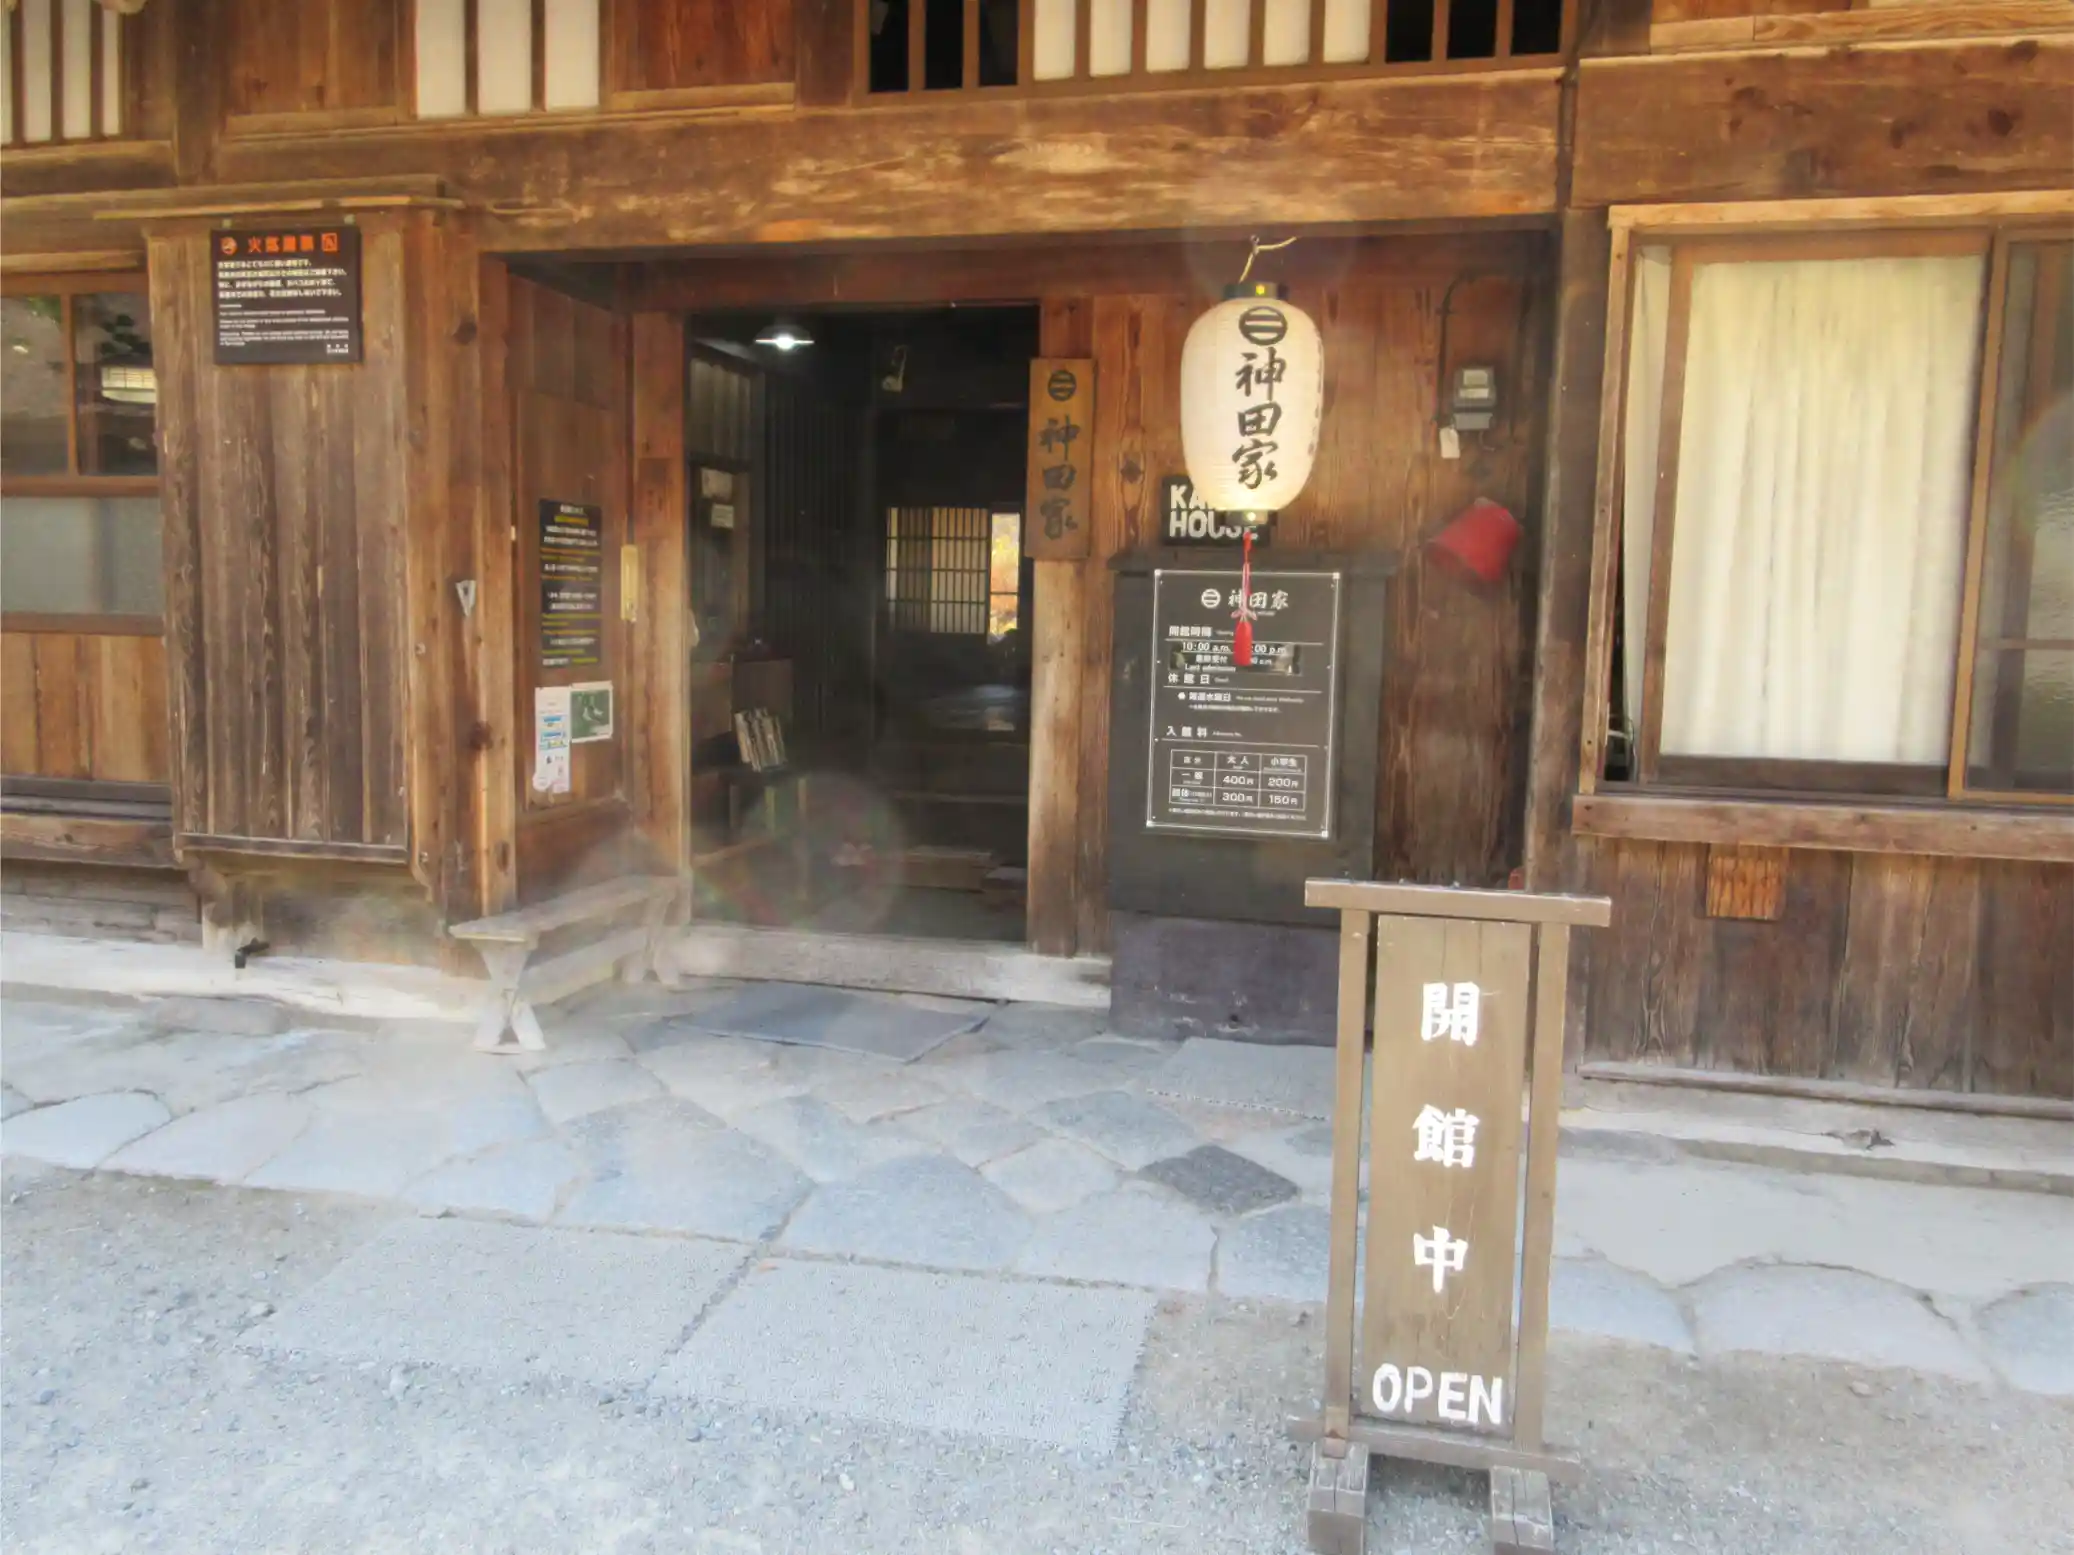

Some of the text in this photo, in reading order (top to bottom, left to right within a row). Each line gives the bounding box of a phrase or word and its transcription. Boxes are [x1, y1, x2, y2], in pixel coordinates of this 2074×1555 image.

[1231, 346, 1288, 491] 神田家
[1038, 413, 1081, 540] 神田家
[1227, 590, 1289, 610] 神田家
[1182, 641, 1211, 652] 10:00
[1222, 792, 1254, 803] 300円
[1269, 795, 1299, 805] 150円
[1223, 775, 1254, 785] 400円
[1268, 777, 1299, 788] 200円
[1412, 980, 1481, 1294] 開館中
[1372, 1362, 1503, 1425] OPEN
